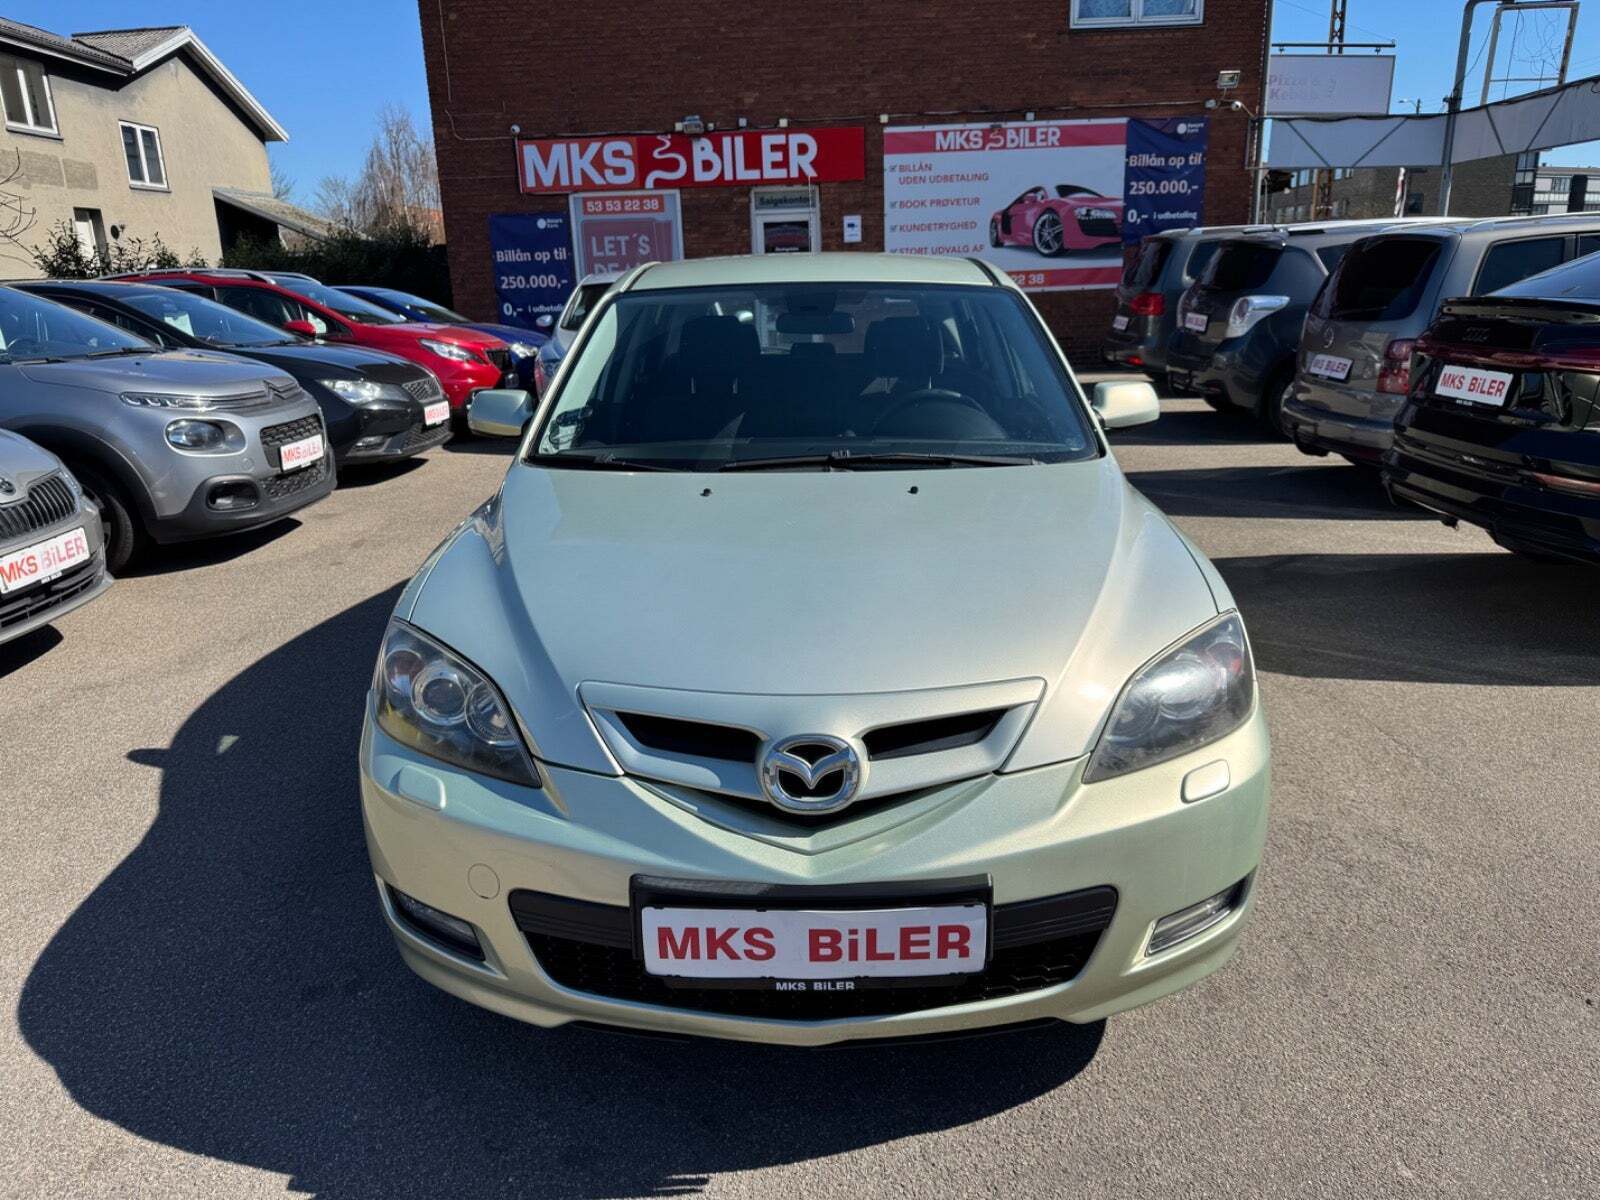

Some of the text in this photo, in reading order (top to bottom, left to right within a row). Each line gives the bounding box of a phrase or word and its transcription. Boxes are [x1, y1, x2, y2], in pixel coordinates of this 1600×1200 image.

[935, 127, 1061, 150] MKS BILER
[523, 133, 818, 187] MKS BILER
[898, 162, 932, 172] BILLÅN
[1129, 152, 1202, 169] Billån op til
[899, 173, 989, 185] UDEN UDBETALING
[1129, 180, 1199, 195] 250.000,-
[586, 198, 660, 212] 53 53 22 38
[899, 197, 980, 209] BOOK PRØVETUR
[1127, 209, 1148, 224] 0,-
[899, 221, 977, 232] KUNDETRYGHED
[496, 247, 567, 264] Billån op til
[931, 244, 969, 255] UDVALG
[500, 273, 568, 289] 250.000,-
[1028, 273, 1045, 285] 38
[503, 302, 523, 317] 0,-
[1440, 373, 1506, 398] MKS BiLER
[0, 555, 38, 584] MKS
[657, 925, 971, 962] MKS BiLER
[776, 981, 807, 991] MKS
